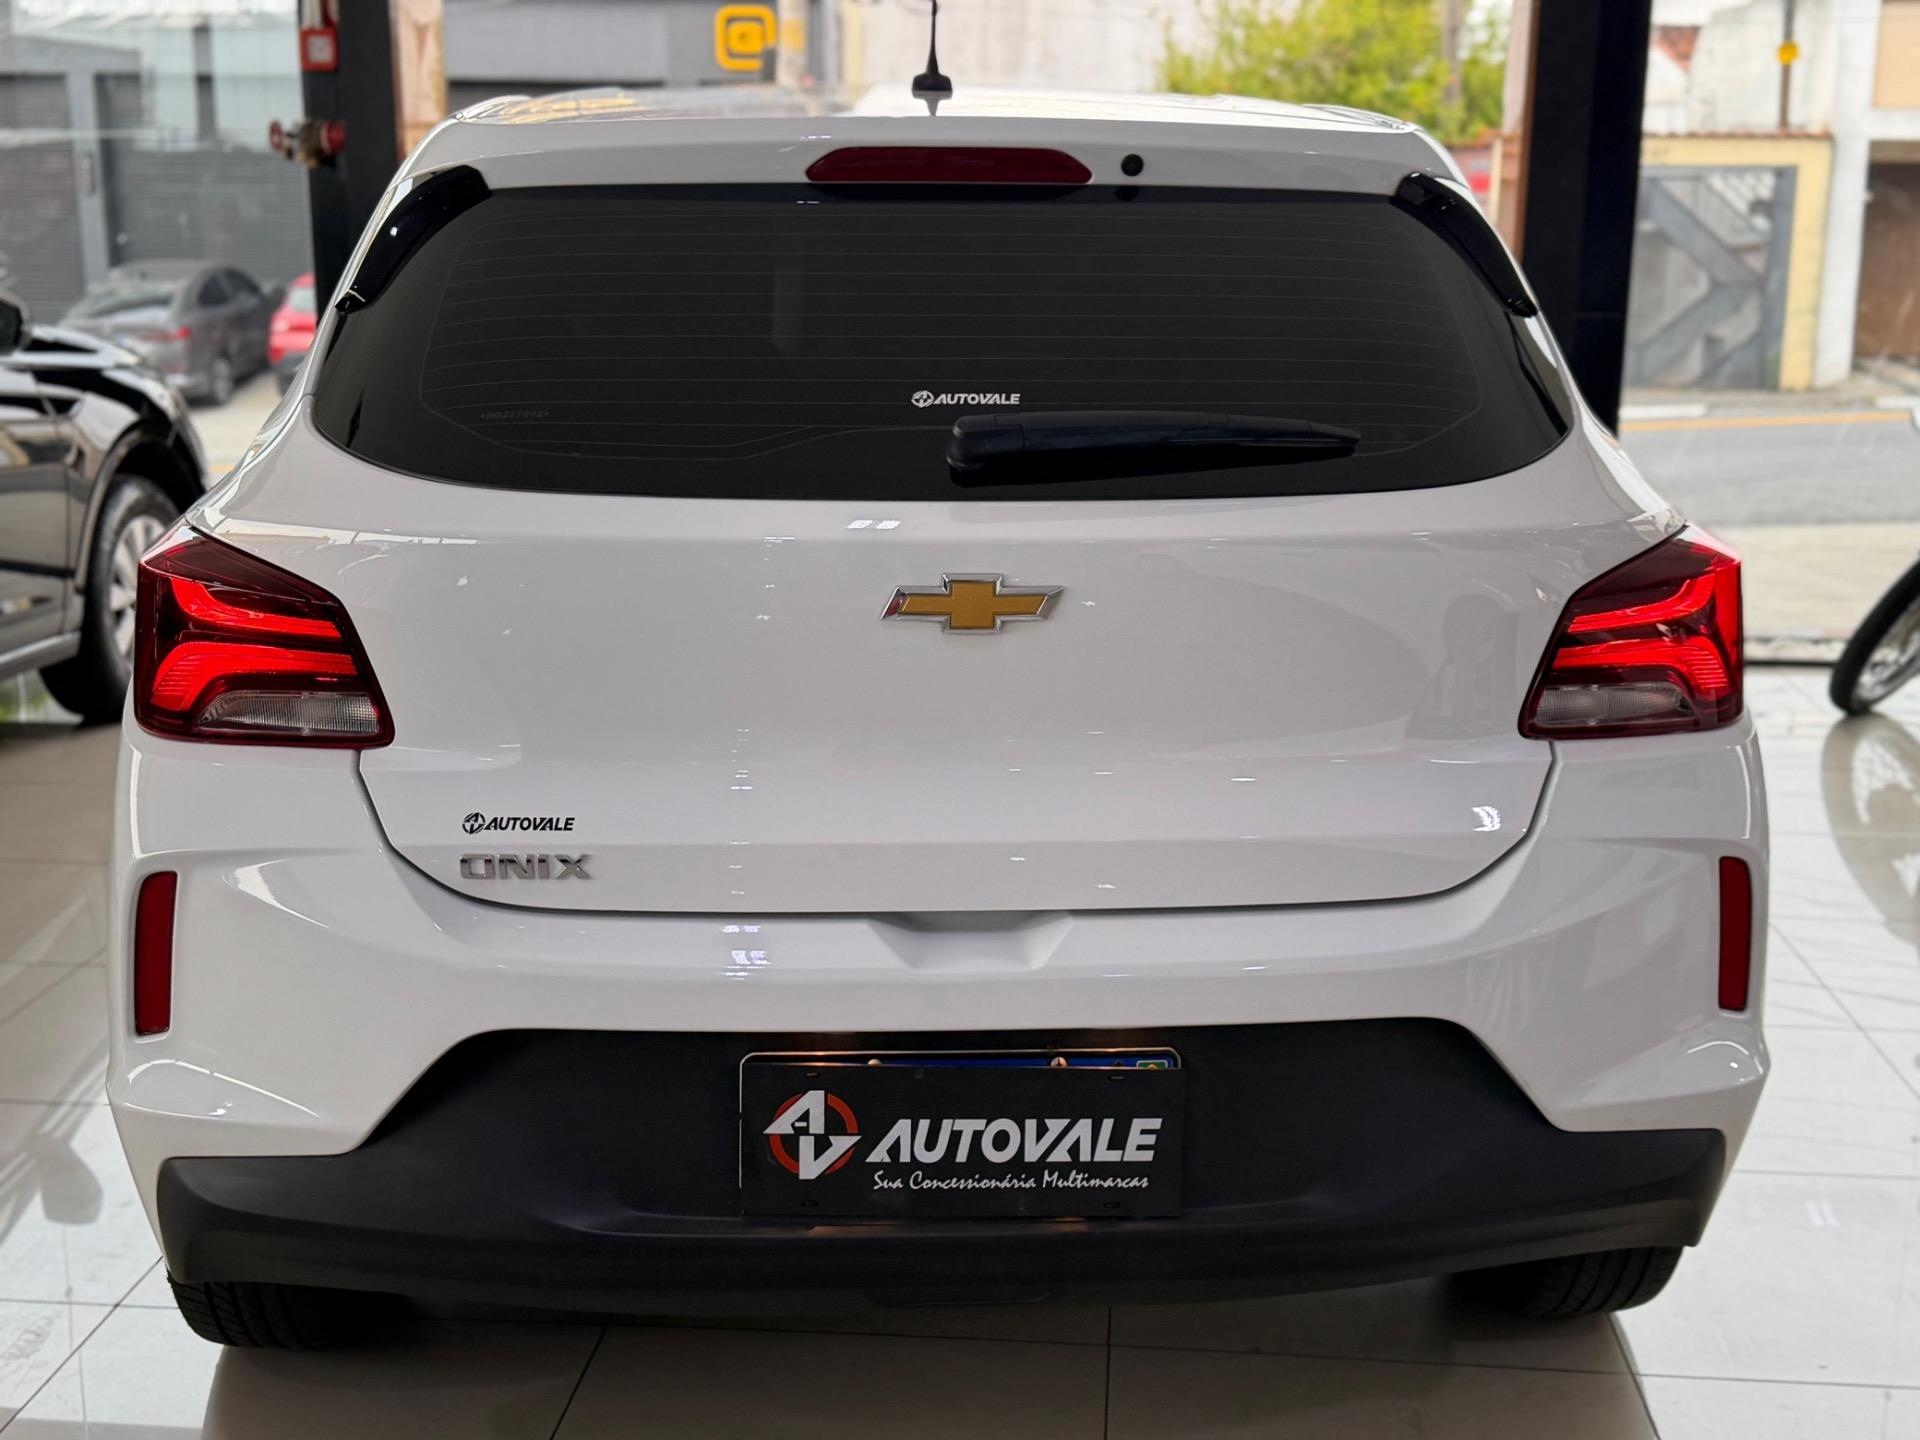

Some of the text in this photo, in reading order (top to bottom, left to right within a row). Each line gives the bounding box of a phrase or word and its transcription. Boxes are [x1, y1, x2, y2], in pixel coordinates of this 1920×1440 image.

[933, 393, 1021, 405] AUTOVALE
[484, 817, 576, 831] AUTOVALE
[460, 853, 592, 880] ONIX
[864, 1118, 1163, 1164] AUTOVALE
[873, 1169, 1150, 1190] Sua Concessionária Multimarcas
